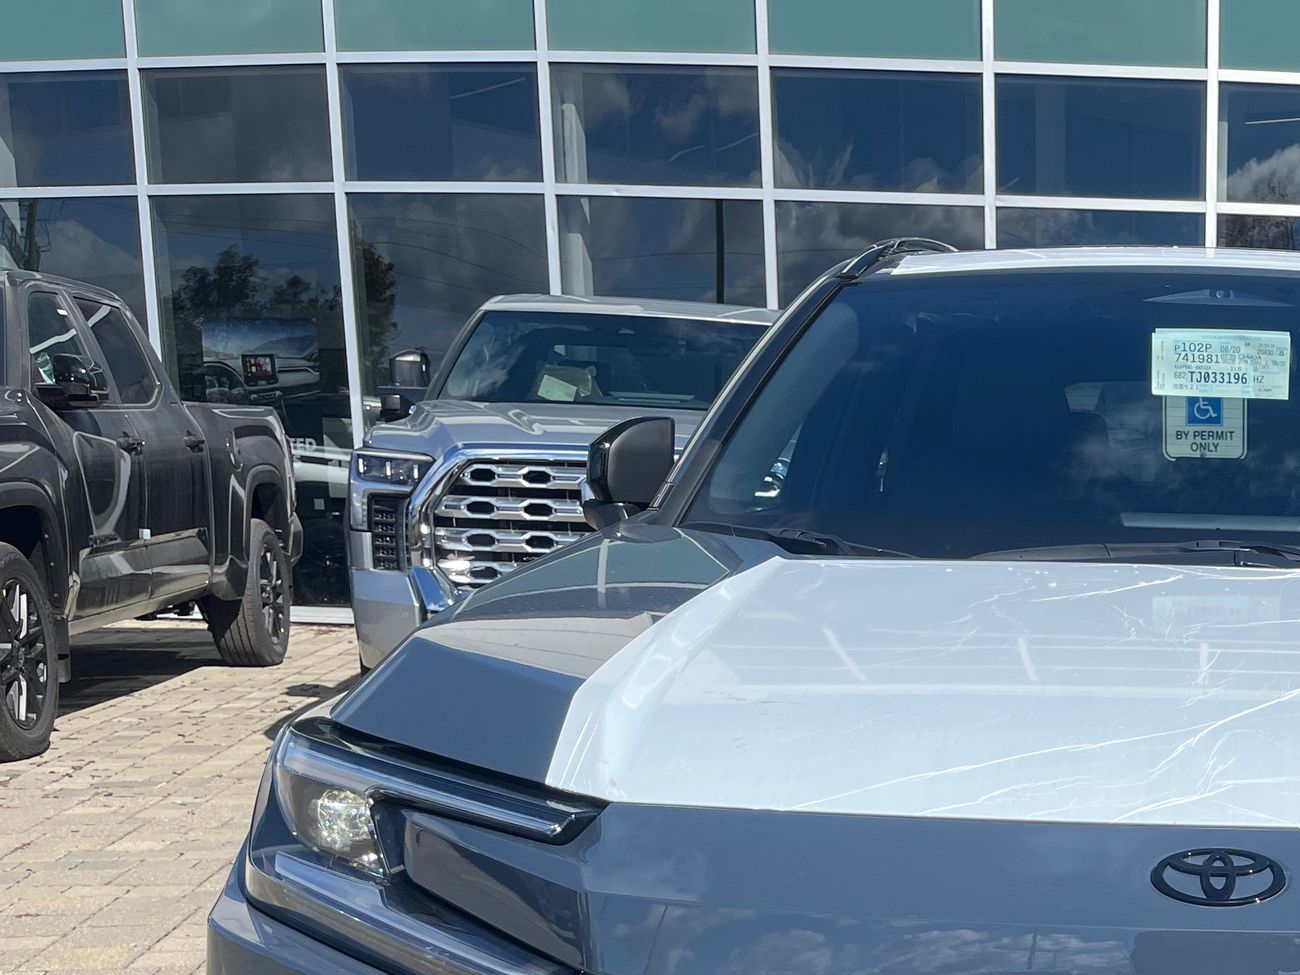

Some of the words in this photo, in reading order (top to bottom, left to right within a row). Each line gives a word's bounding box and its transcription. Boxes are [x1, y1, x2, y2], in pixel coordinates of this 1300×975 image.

[1174, 353, 1221, 364] 741981
[1188, 371, 1248, 384] TJ033196
[1175, 431, 1189, 440] BY
[1193, 431, 1235, 440] PERMIT
[1190, 442, 1220, 452] ONLY
